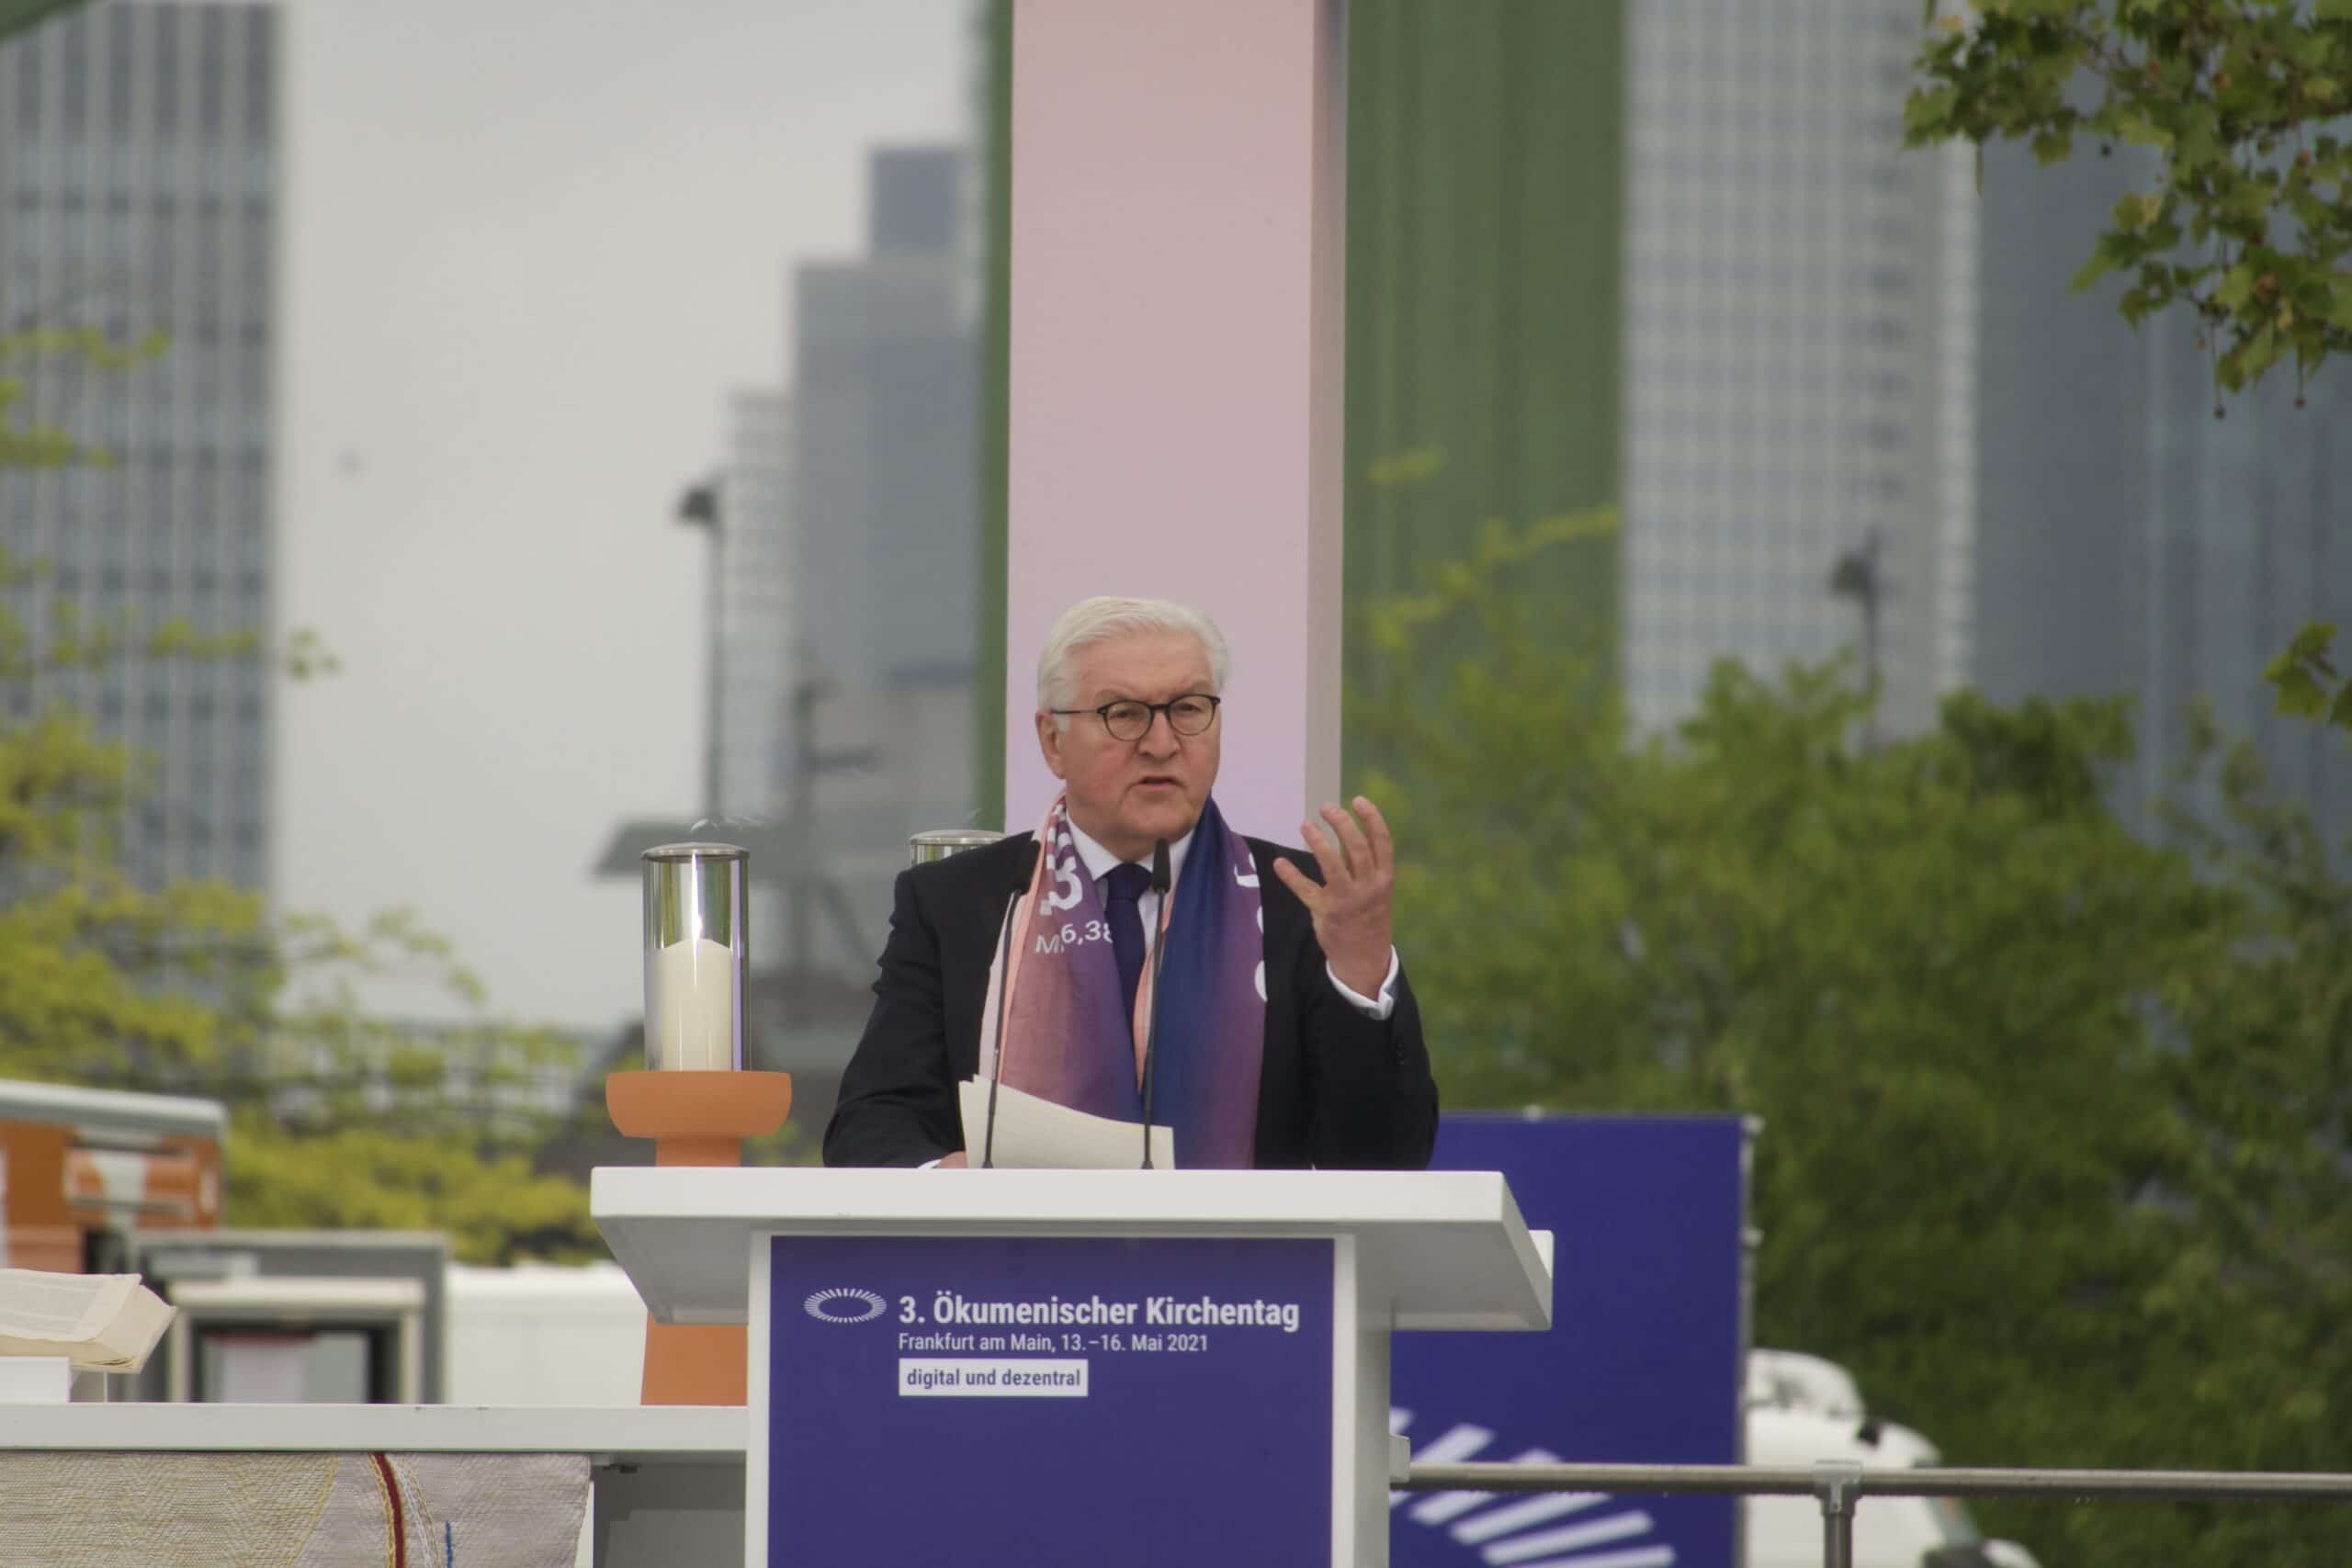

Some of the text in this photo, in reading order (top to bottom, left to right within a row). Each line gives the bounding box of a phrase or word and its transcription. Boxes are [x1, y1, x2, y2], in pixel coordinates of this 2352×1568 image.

[899, 1290, 1300, 1332] 3. Ökumenischer Kirchentag
[899, 1332, 975, 1351] Frankfurt
[978, 1337, 1006, 1352] am
[1010, 1333, 1057, 1354] Main,
[1131, 1334, 1163, 1352] Mai
[1167, 1334, 1208, 1353] 2021
[906, 1368, 1081, 1391] digital und dezentral
